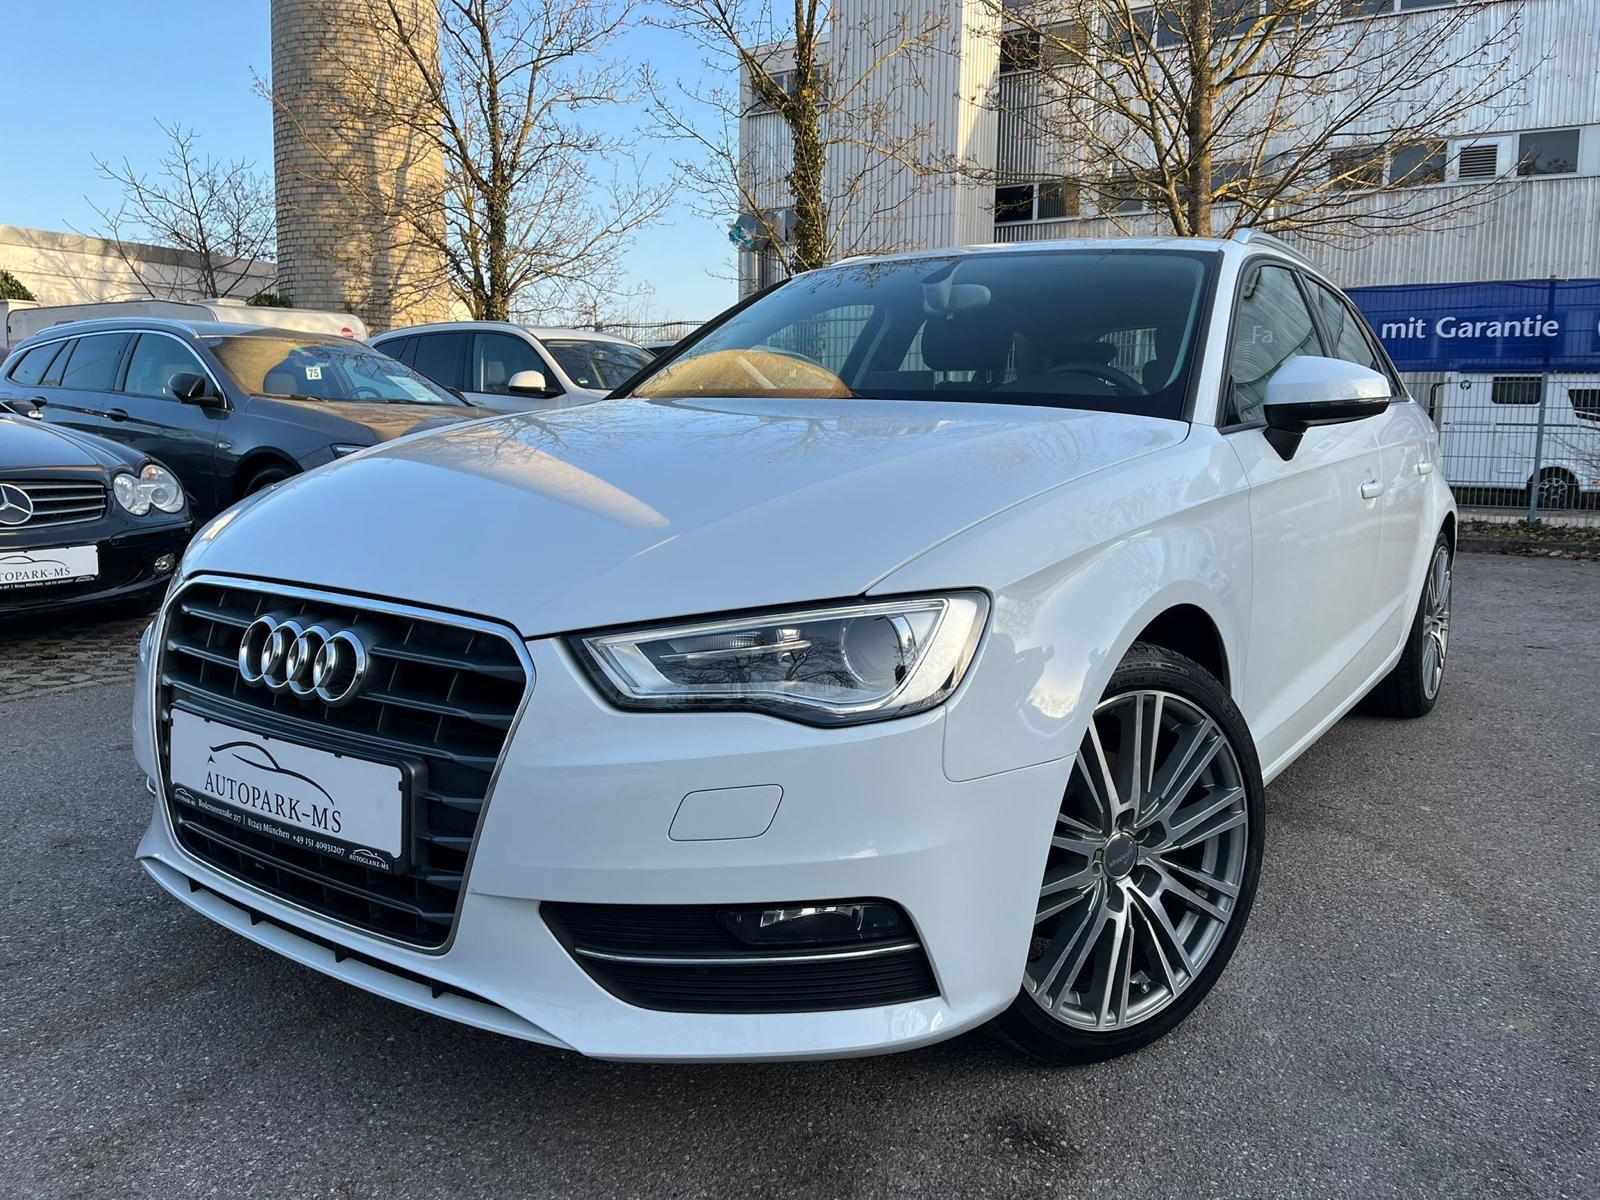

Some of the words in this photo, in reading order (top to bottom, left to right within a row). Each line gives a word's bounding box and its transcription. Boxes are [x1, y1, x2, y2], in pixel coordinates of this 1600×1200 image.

[1381, 316, 1427, 339] mit
[1435, 314, 1559, 339] Garantie
[308, 368, 320, 378] 75
[204, 771, 342, 834] AUTOPARK-MS
[263, 823, 290, 839] München
[292, 834, 304, 845] +49
[305, 837, 315, 847] 151
[348, 853, 389, 870] AUTOGLANZ-MS
